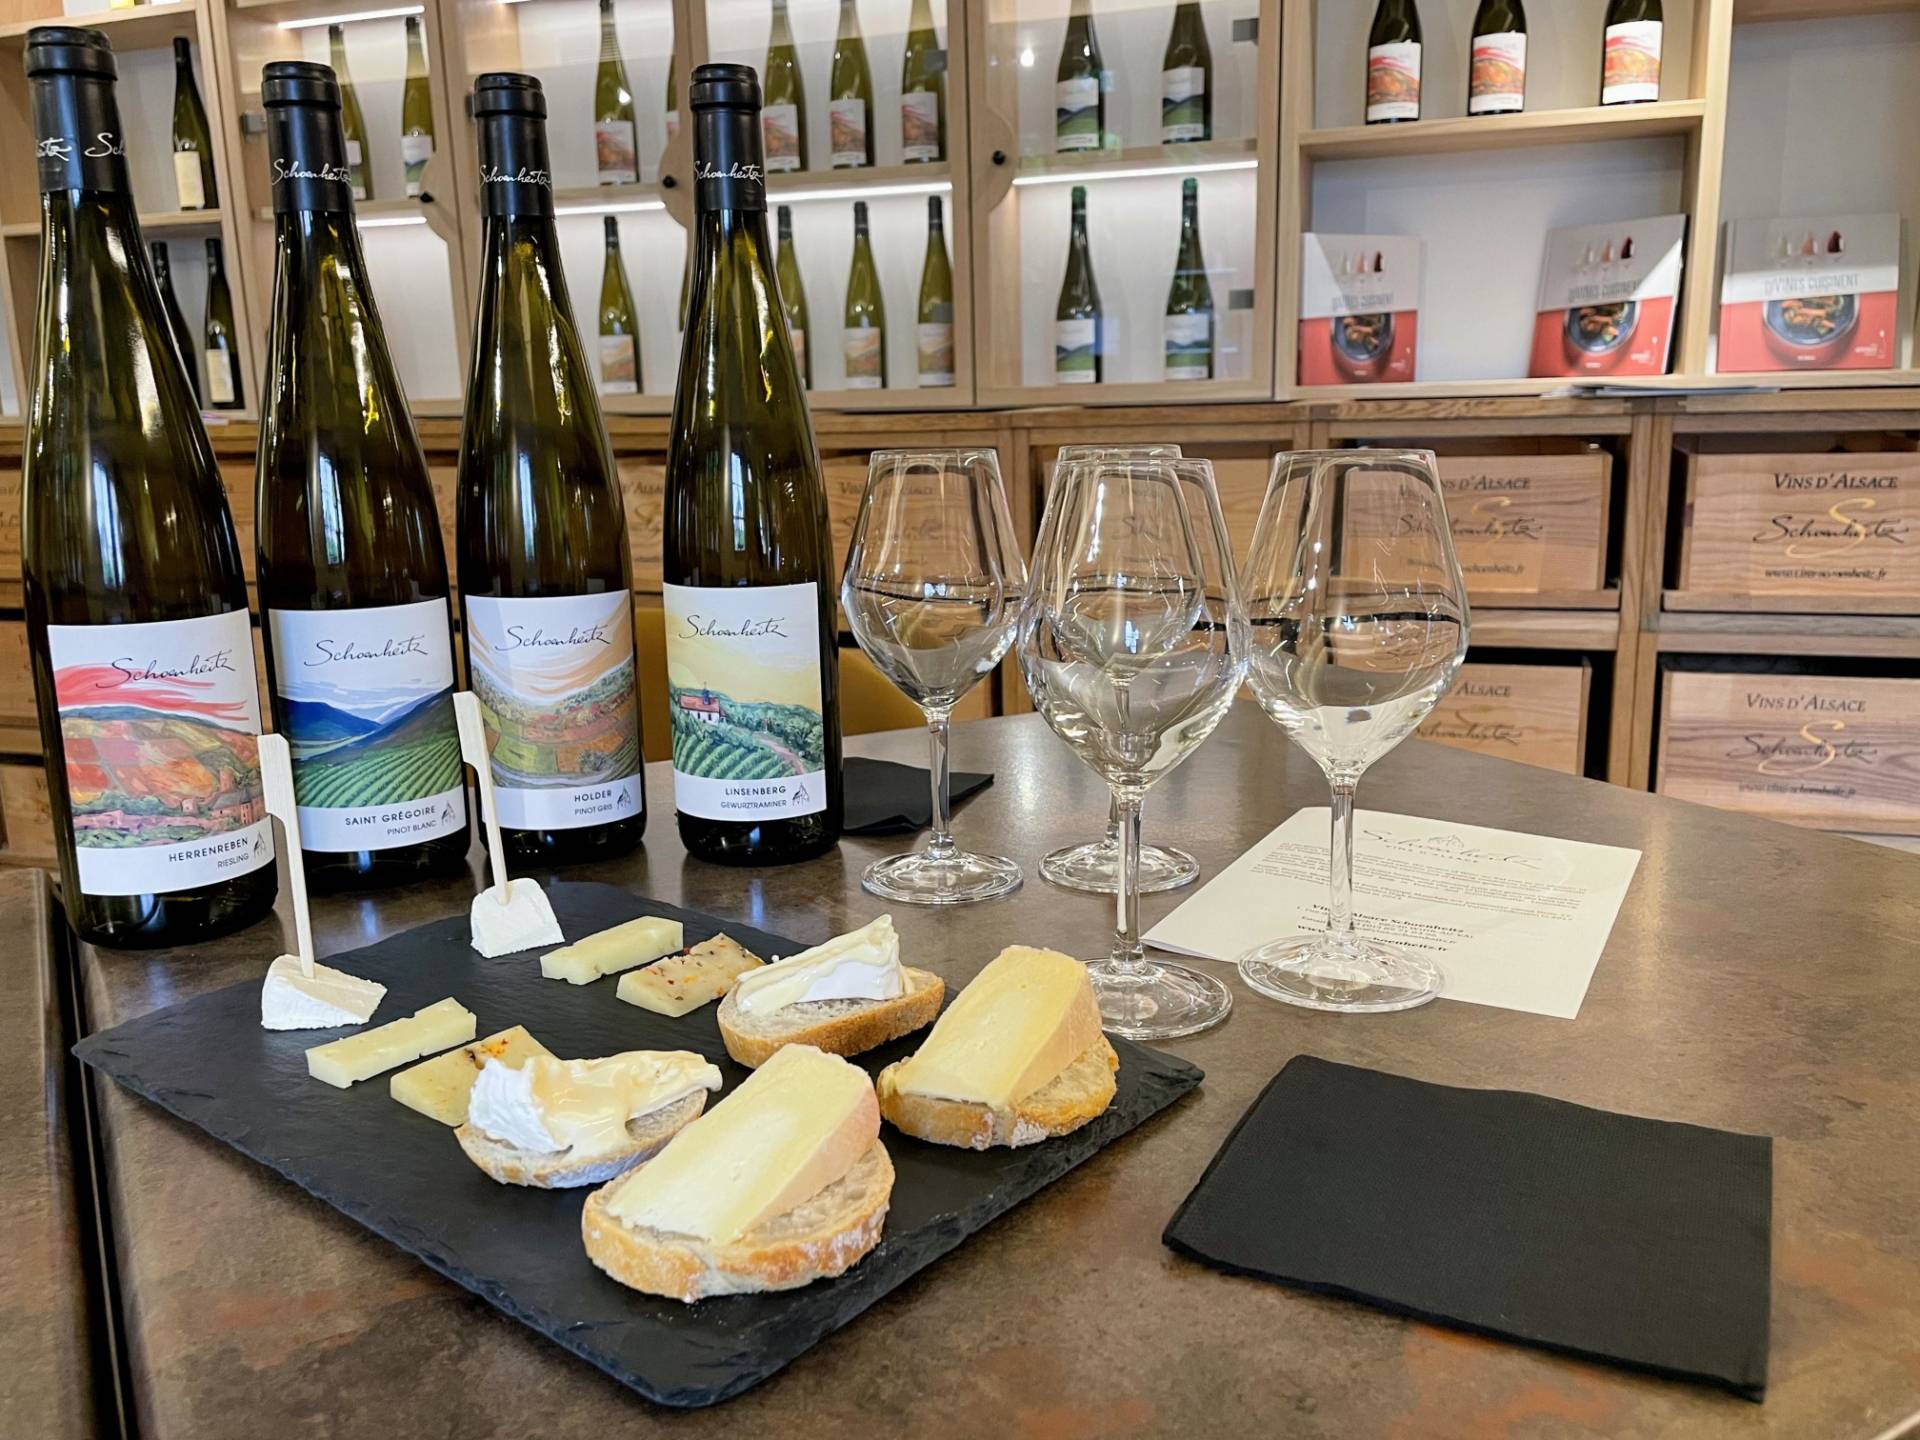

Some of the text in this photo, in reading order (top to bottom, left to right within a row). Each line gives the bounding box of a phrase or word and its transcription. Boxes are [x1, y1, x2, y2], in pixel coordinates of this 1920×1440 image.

[1774, 472, 1899, 490] VINS D'ALSACE
[679, 614, 789, 639] Schoenheitz
[495, 625, 611, 652] Schoenheitz
[303, 634, 429, 667] Schoenheitz
[96, 648, 236, 689] Schoenheitz
[1747, 692, 1867, 713] VINS D'ALSACE
[574, 789, 612, 803] HOLDER
[725, 785, 786, 797] LINSENBERG
[575, 803, 613, 816] PINOT GRIS
[720, 799, 787, 810] GEWURZTRAMINER
[345, 805, 436, 827] SAINT GRÉGOIRE
[387, 819, 437, 837] PINOT BLANC
[169, 838, 249, 863] HERRENREBEN
[217, 852, 249, 870] RIESLING
